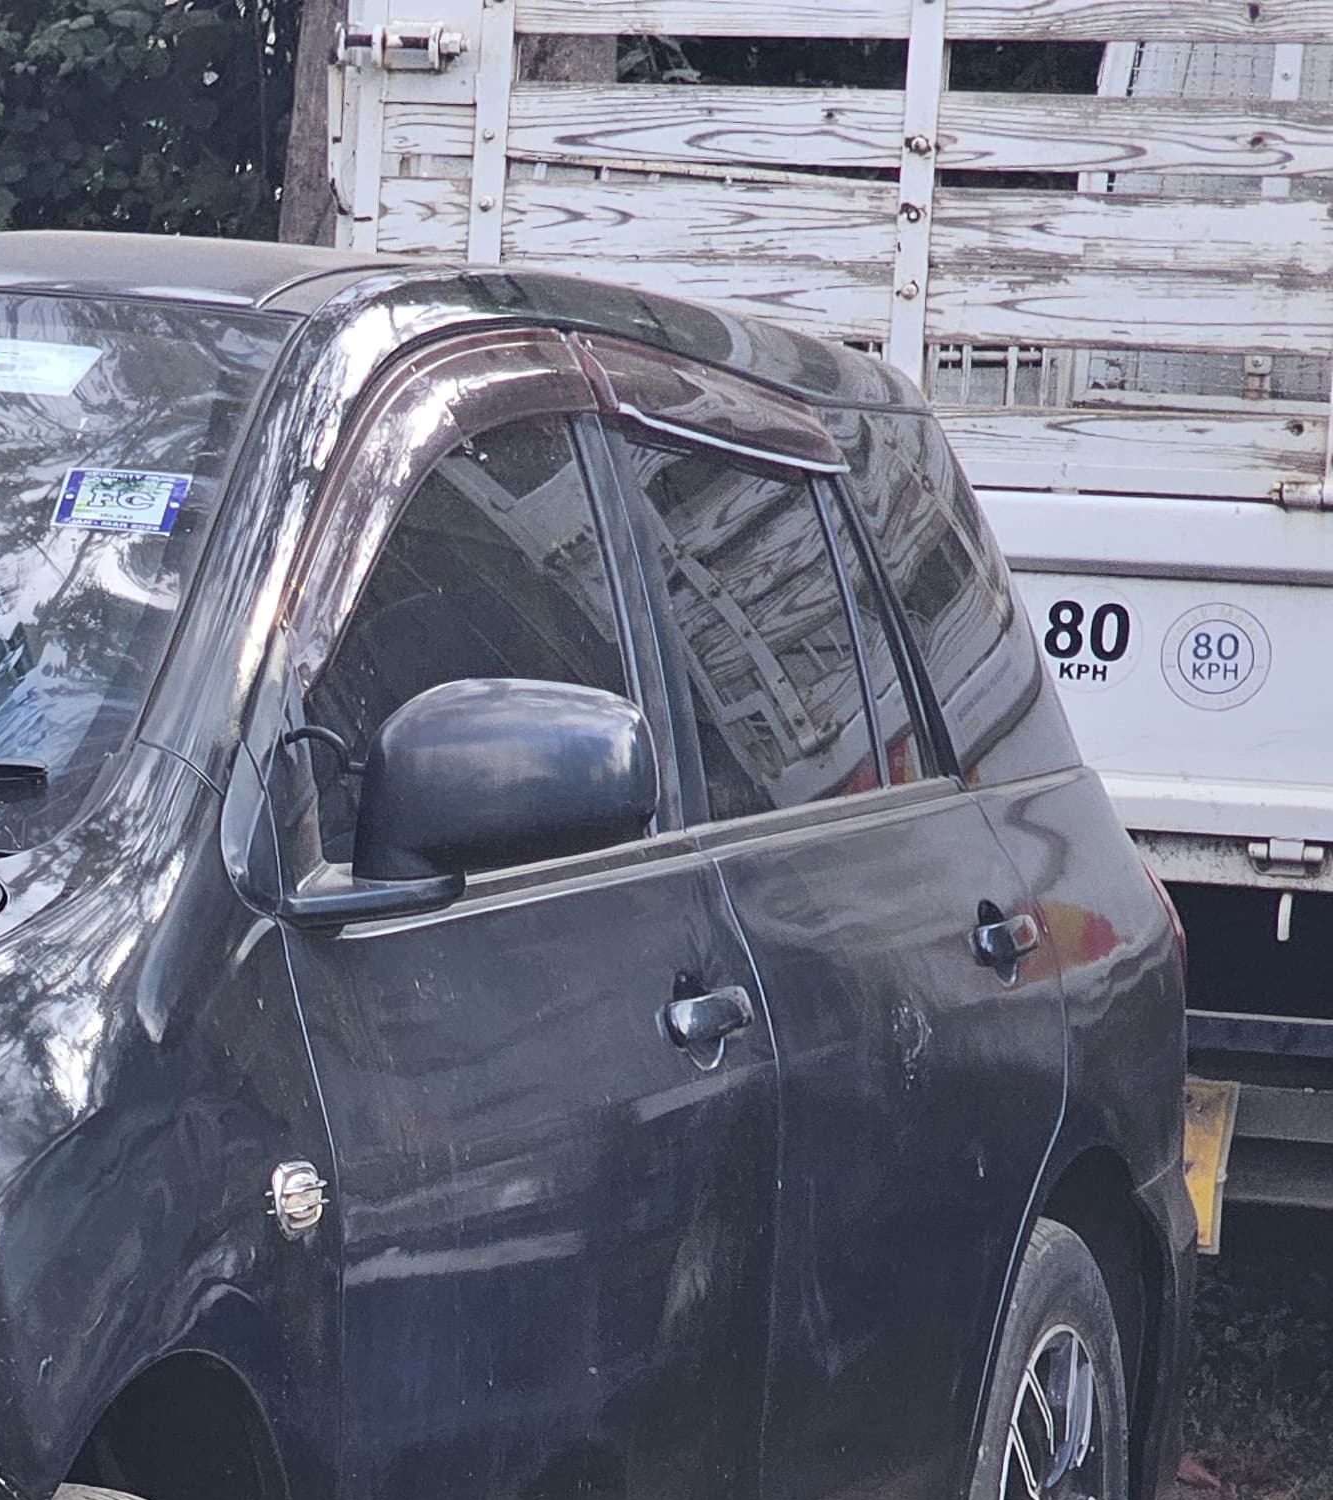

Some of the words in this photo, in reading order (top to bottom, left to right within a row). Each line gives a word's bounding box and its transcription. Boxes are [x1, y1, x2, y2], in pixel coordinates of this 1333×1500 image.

[1044, 599, 1130, 662] 80
[1192, 632, 1239, 660] 80
[1059, 662, 1107, 681] KPH
[1192, 662, 1238, 680] KPH
